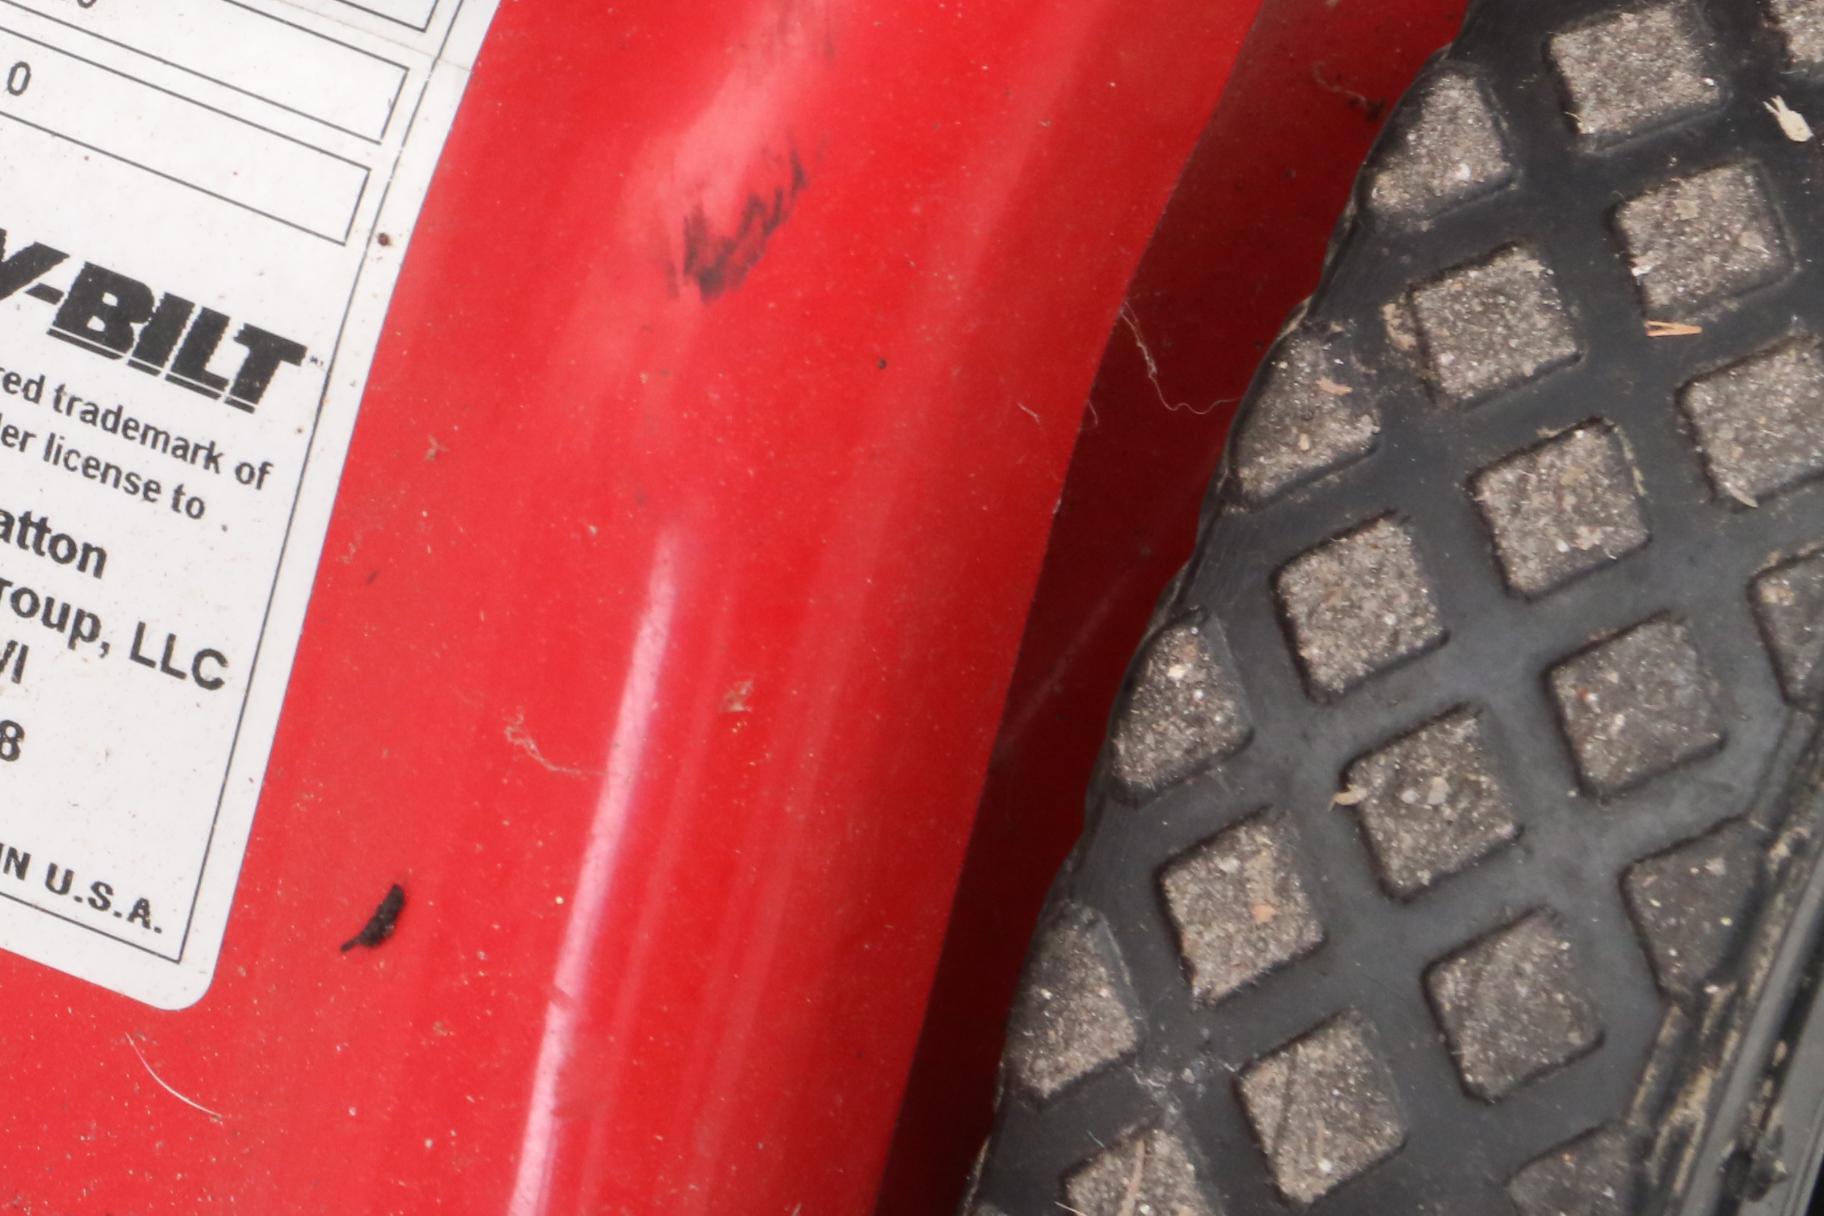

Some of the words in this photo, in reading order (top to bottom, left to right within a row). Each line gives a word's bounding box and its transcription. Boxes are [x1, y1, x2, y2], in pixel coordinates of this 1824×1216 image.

[44, 433, 161, 502] license
[172, 484, 205, 519] to
[53, 384, 223, 474] trademark
[235, 462, 273, 490] of
[130, 622, 227, 690] LLC
[45, 863, 161, 933] U.S.A.
